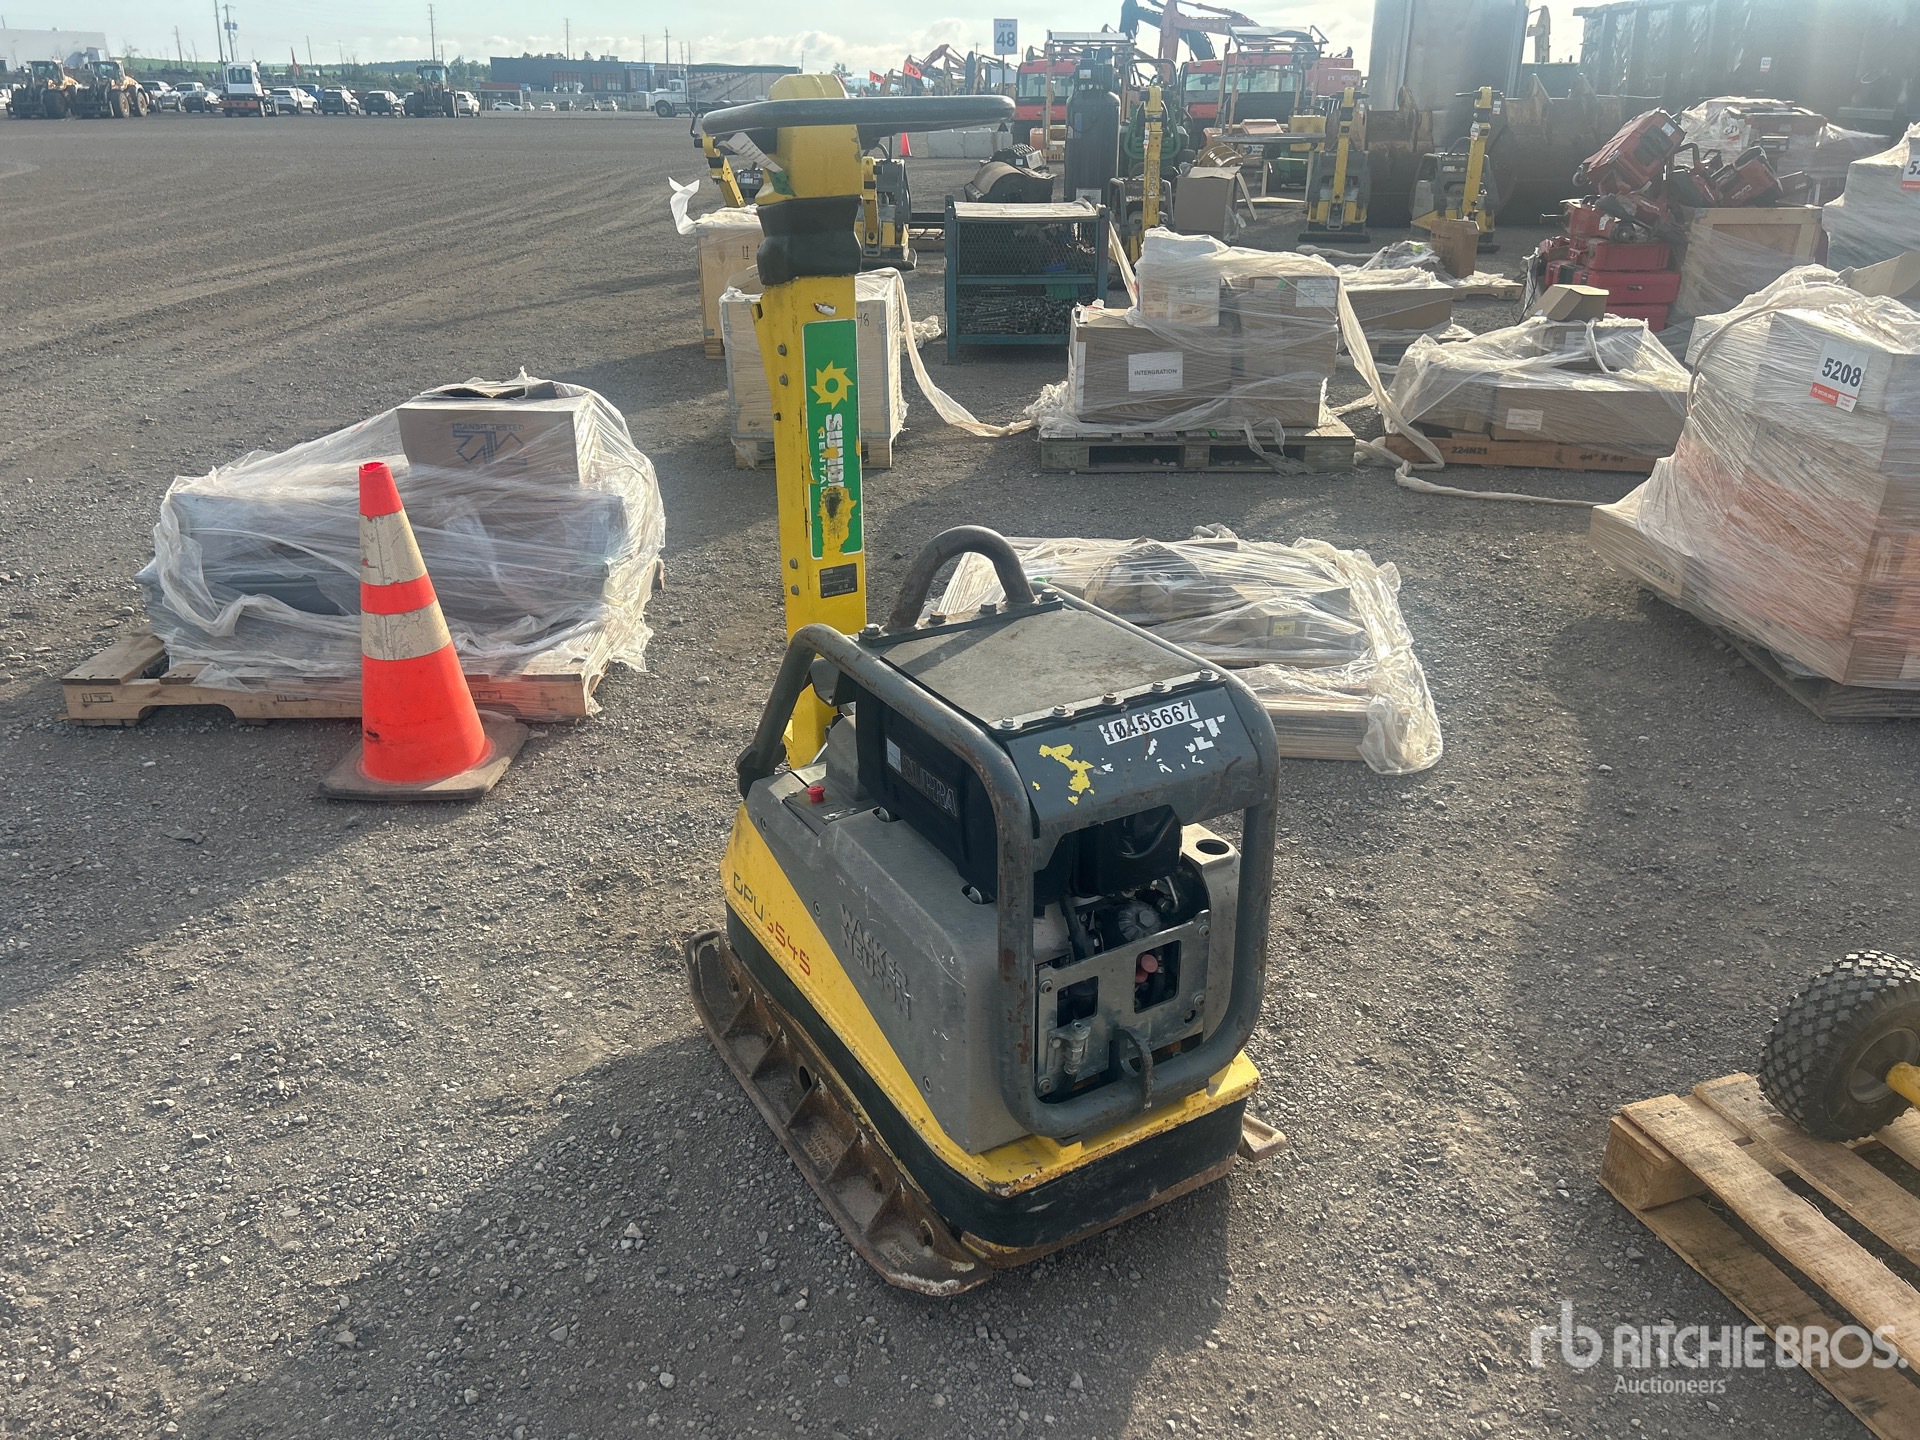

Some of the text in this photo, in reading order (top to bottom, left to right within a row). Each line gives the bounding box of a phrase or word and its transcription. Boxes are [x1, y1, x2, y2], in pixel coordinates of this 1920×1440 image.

[996, 31, 1016, 47] 48
[1133, 368, 1178, 376] INTERGRATION
[1821, 357, 1862, 388] 5208
[451, 423, 525, 431] TRANSIT TESTED
[902, 754, 958, 818] SUPRA
